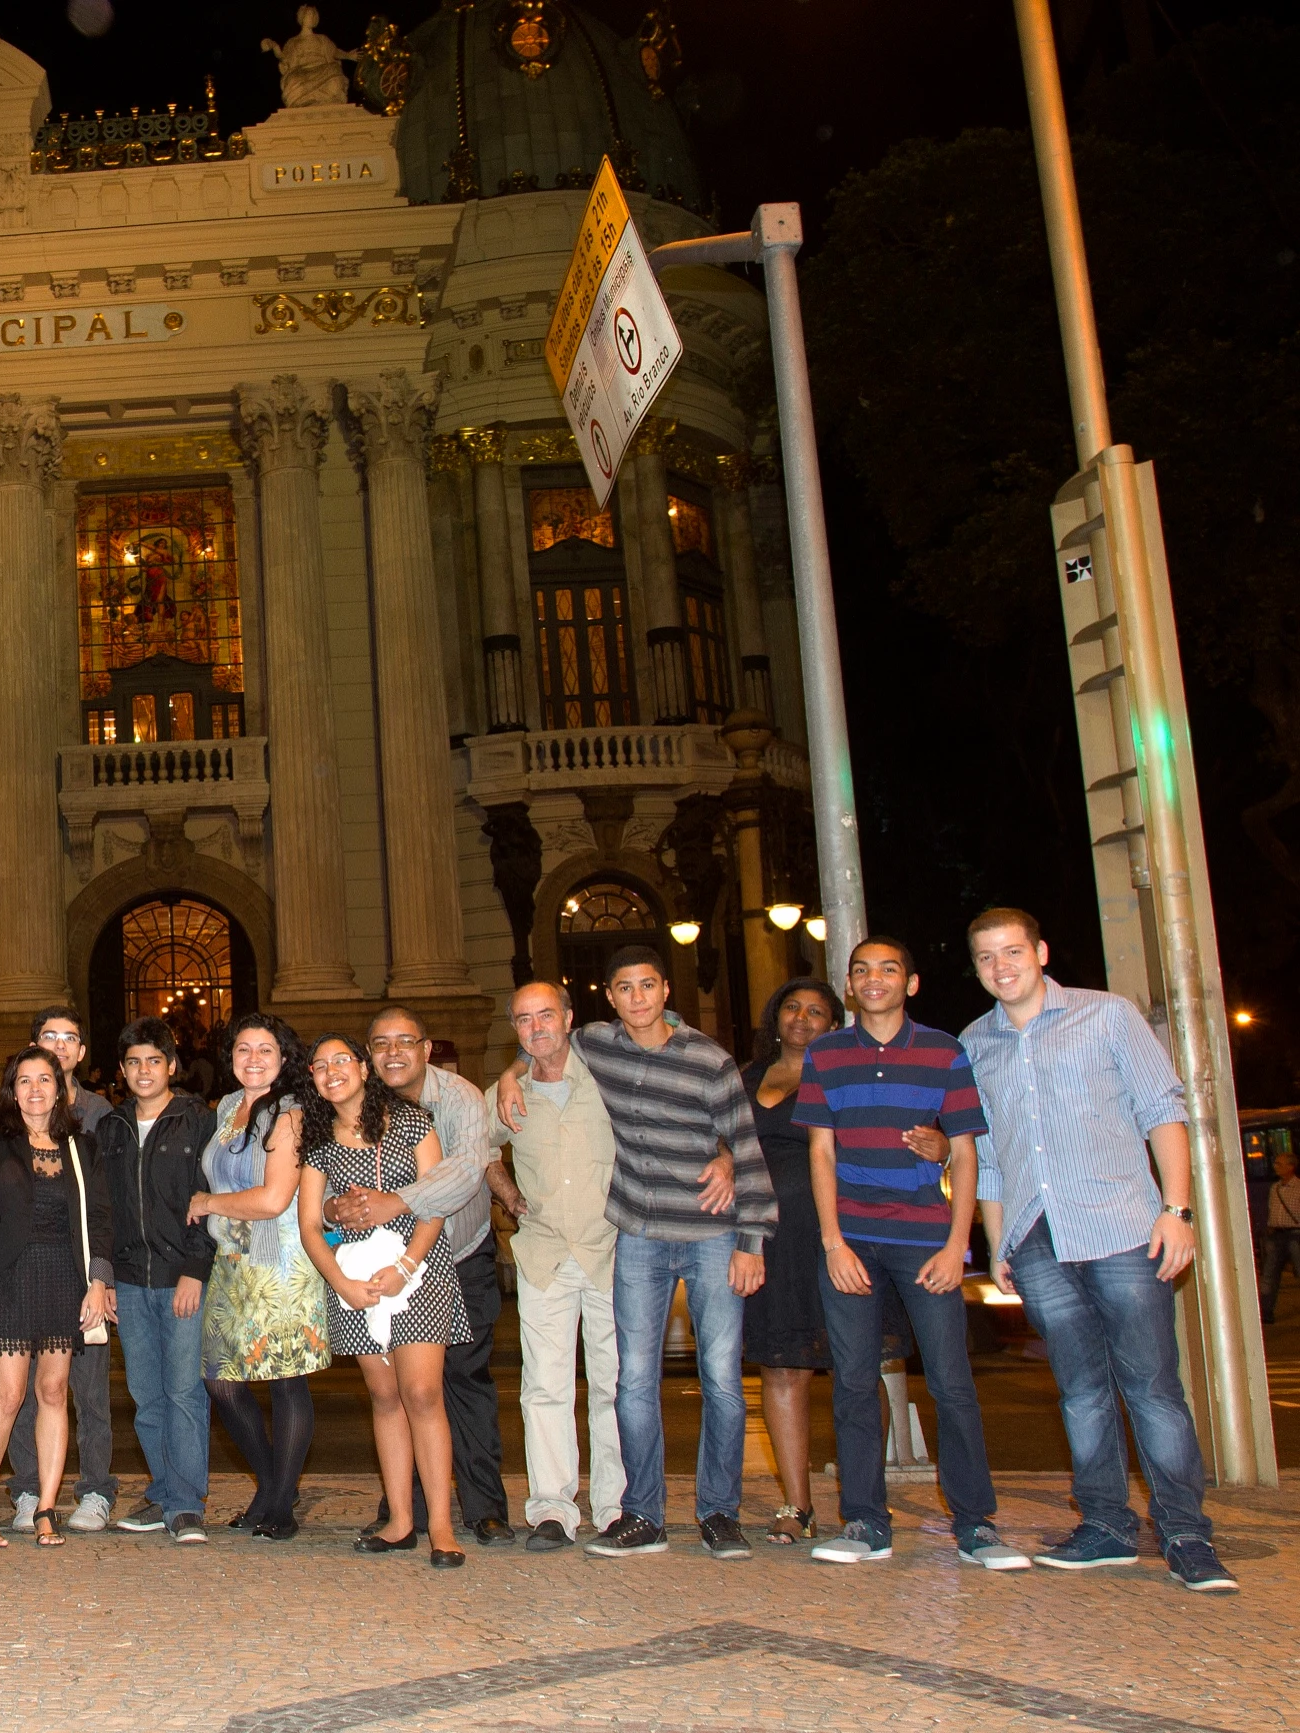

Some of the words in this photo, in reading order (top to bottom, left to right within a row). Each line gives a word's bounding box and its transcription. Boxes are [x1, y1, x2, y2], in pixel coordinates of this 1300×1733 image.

[275, 163, 373, 184] POESIA
[550, 323, 563, 357] Dias
[572, 264, 583, 295] das
[592, 191, 609, 228] 21h
[579, 289, 591, 320] das
[587, 271, 595, 292] 5
[600, 222, 617, 255] 15h
[603, 250, 633, 312] Municipais
[569, 361, 588, 411] Demais
[623, 407, 635, 428] Av.
[631, 386, 645, 411] Rio
[642, 345, 670, 391] Branco
